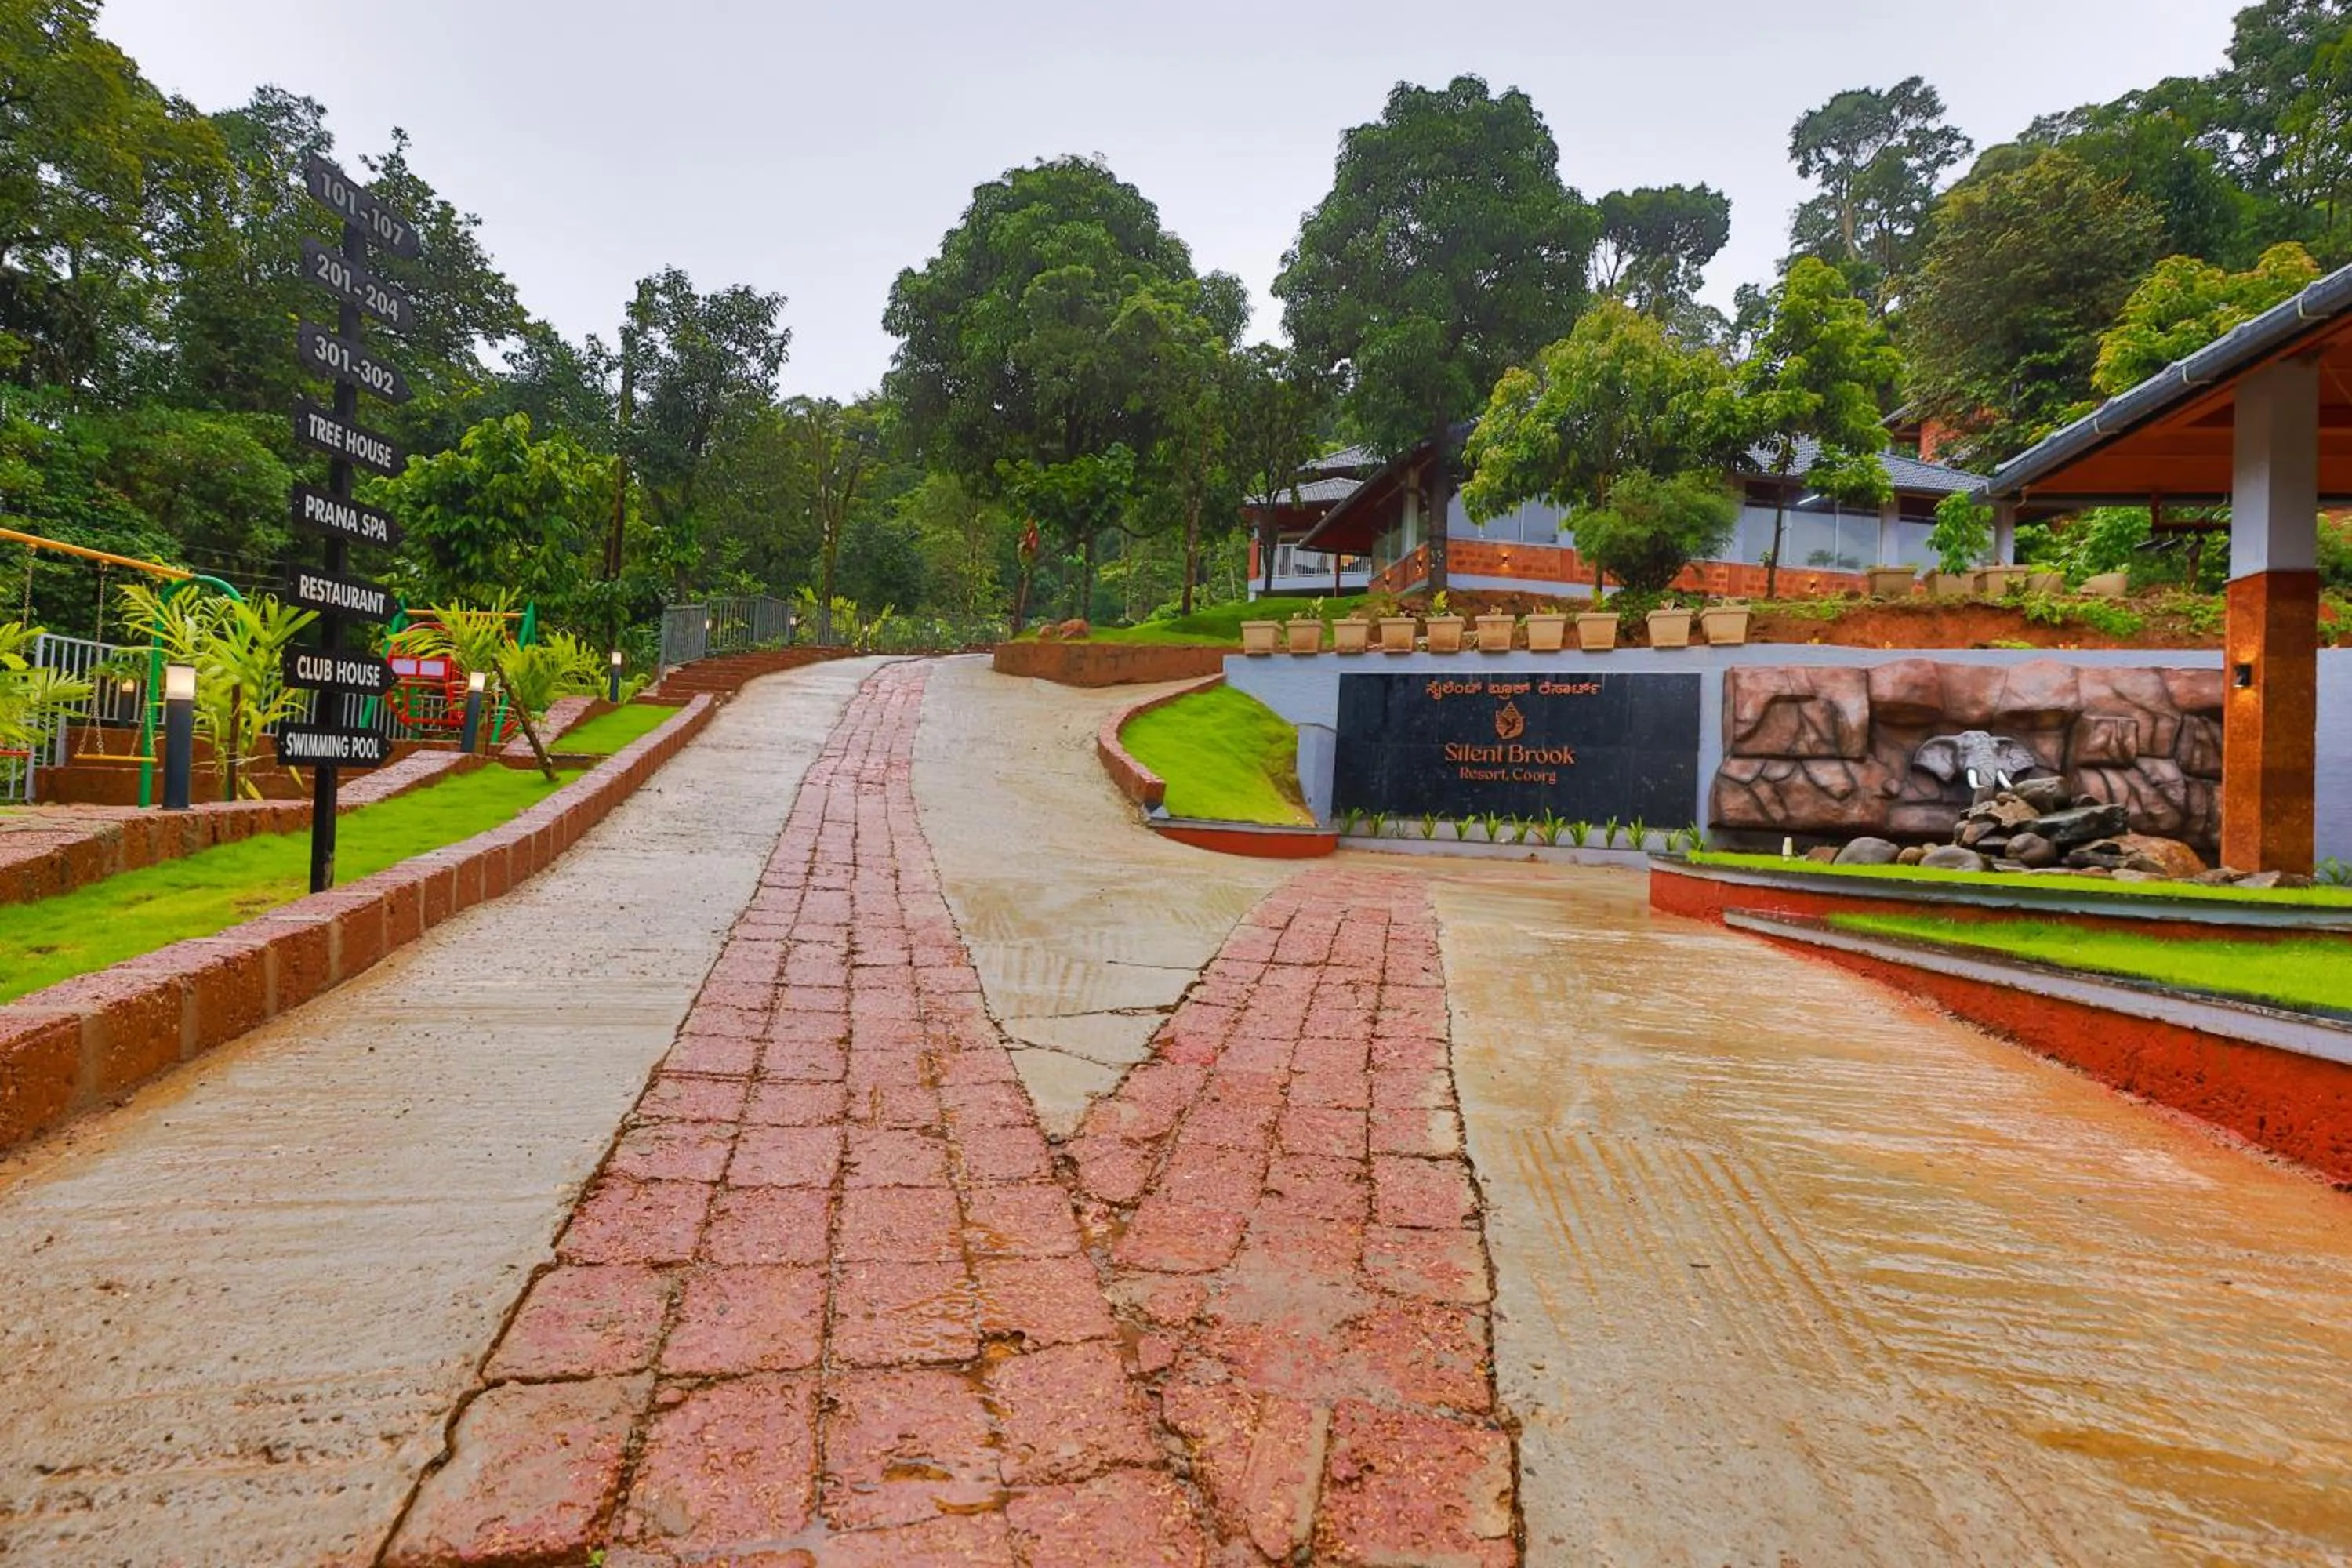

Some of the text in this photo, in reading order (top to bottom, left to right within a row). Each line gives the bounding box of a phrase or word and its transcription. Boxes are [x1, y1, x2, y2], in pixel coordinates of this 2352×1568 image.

[321, 172, 405, 245] 101-107
[316, 253, 400, 322] 201-204
[314, 335, 394, 396] 301-302
[308, 413, 392, 470] TREE HOUSE
[304, 494, 387, 542] PRANA SPA
[299, 574, 385, 615] RESTAURANT
[297, 655, 380, 688] CLUB HOUSE
[285, 731, 380, 760] SWIMMING POOL
[1445, 742, 1576, 765] Silent Brook
[1459, 766, 1556, 784] Resort, Coorg
